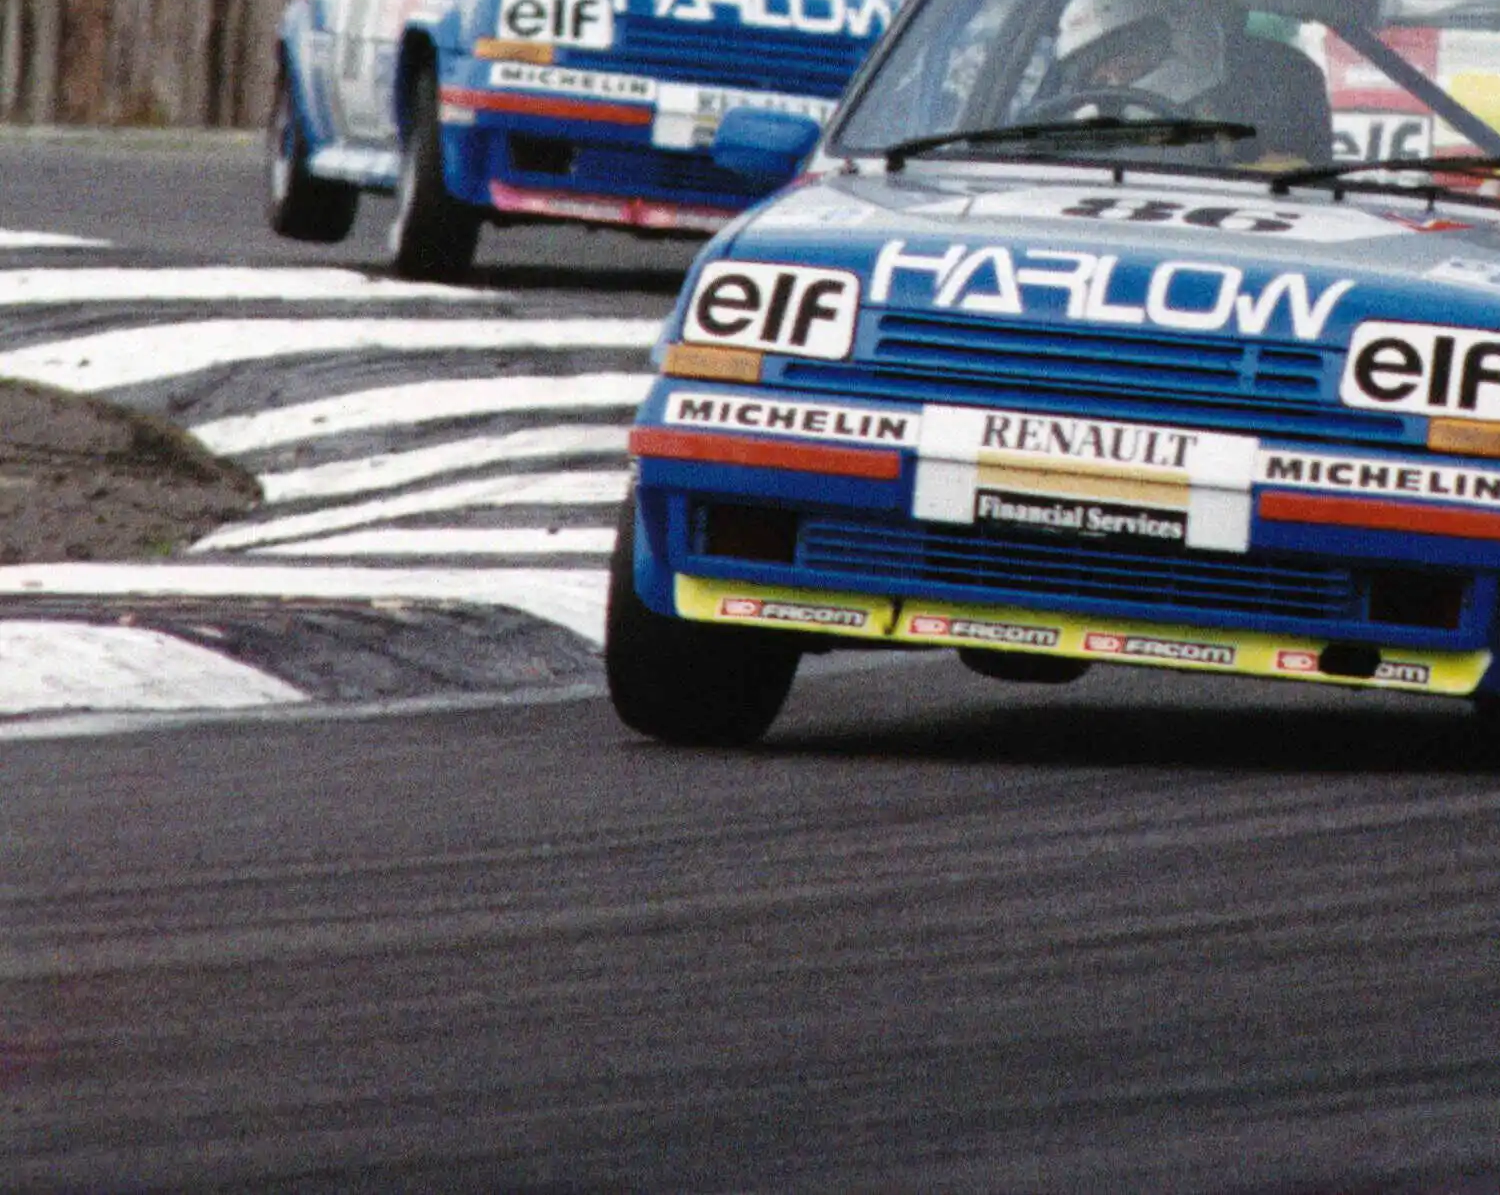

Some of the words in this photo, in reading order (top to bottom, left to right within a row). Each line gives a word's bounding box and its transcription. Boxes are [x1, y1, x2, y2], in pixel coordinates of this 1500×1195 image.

[499, 68, 650, 96] MICHELIN
[1061, 196, 1301, 233] 86
[695, 271, 846, 347] elf
[870, 239, 1356, 338] HARLOW
[677, 397, 908, 441] MICHELIN
[980, 413, 1198, 468] RENAULT
[978, 493, 1084, 528] Financial
[1086, 506, 1184, 540] Services
